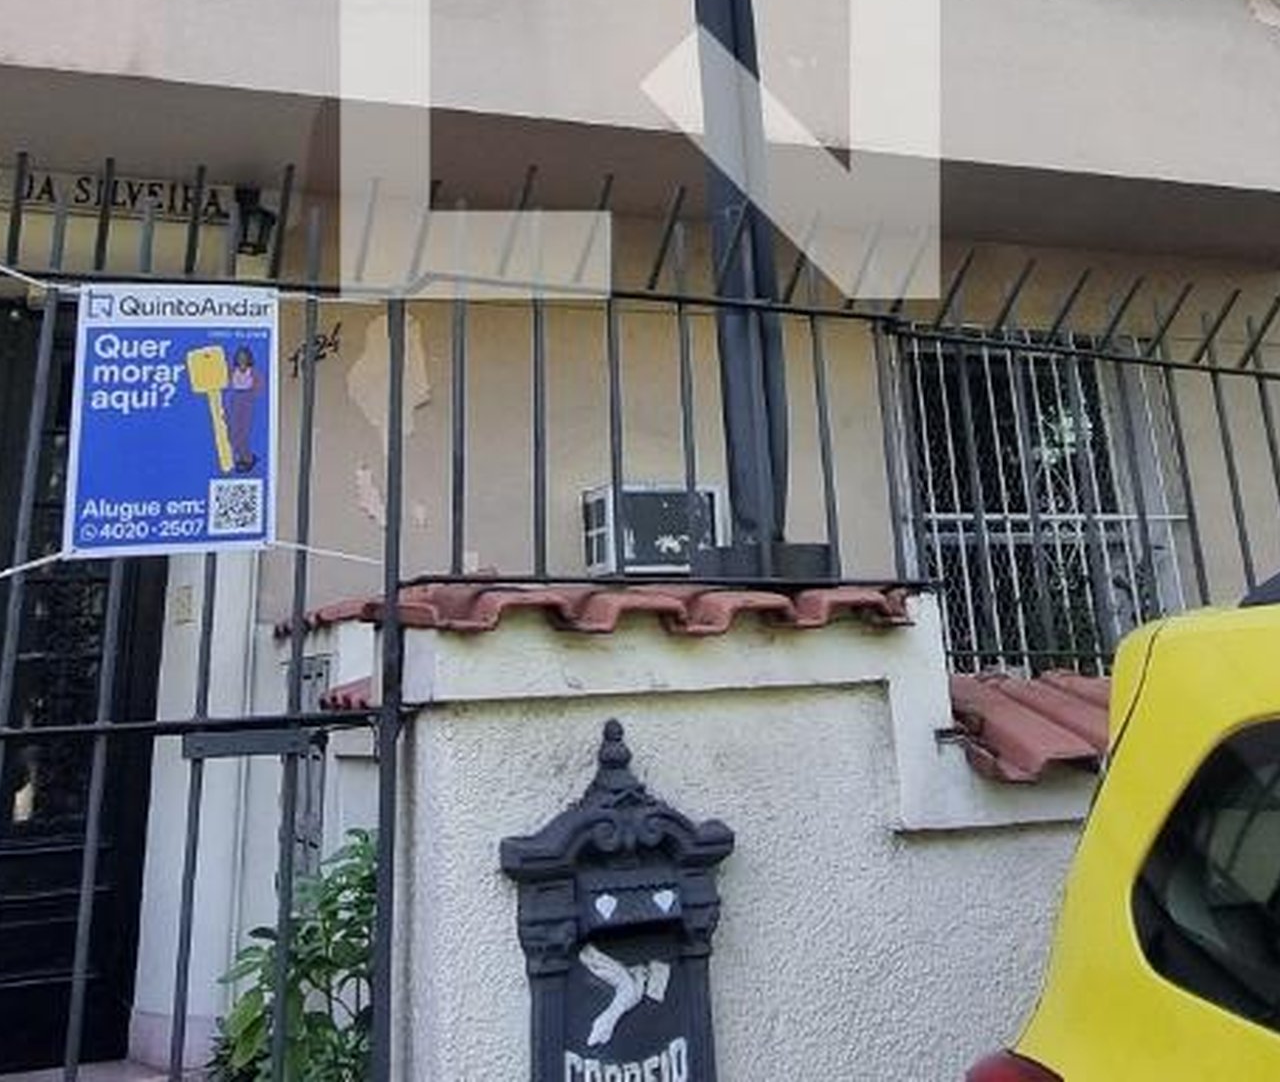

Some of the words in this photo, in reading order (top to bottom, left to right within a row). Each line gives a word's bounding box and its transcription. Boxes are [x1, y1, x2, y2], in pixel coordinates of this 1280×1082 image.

[120, 294, 271, 317] QuintoAndar
[93, 333, 172, 360] Quer
[92, 363, 186, 384] morar
[90, 384, 177, 416] aqui?
[81, 498, 161, 521] Alugue
[166, 499, 205, 515] em:
